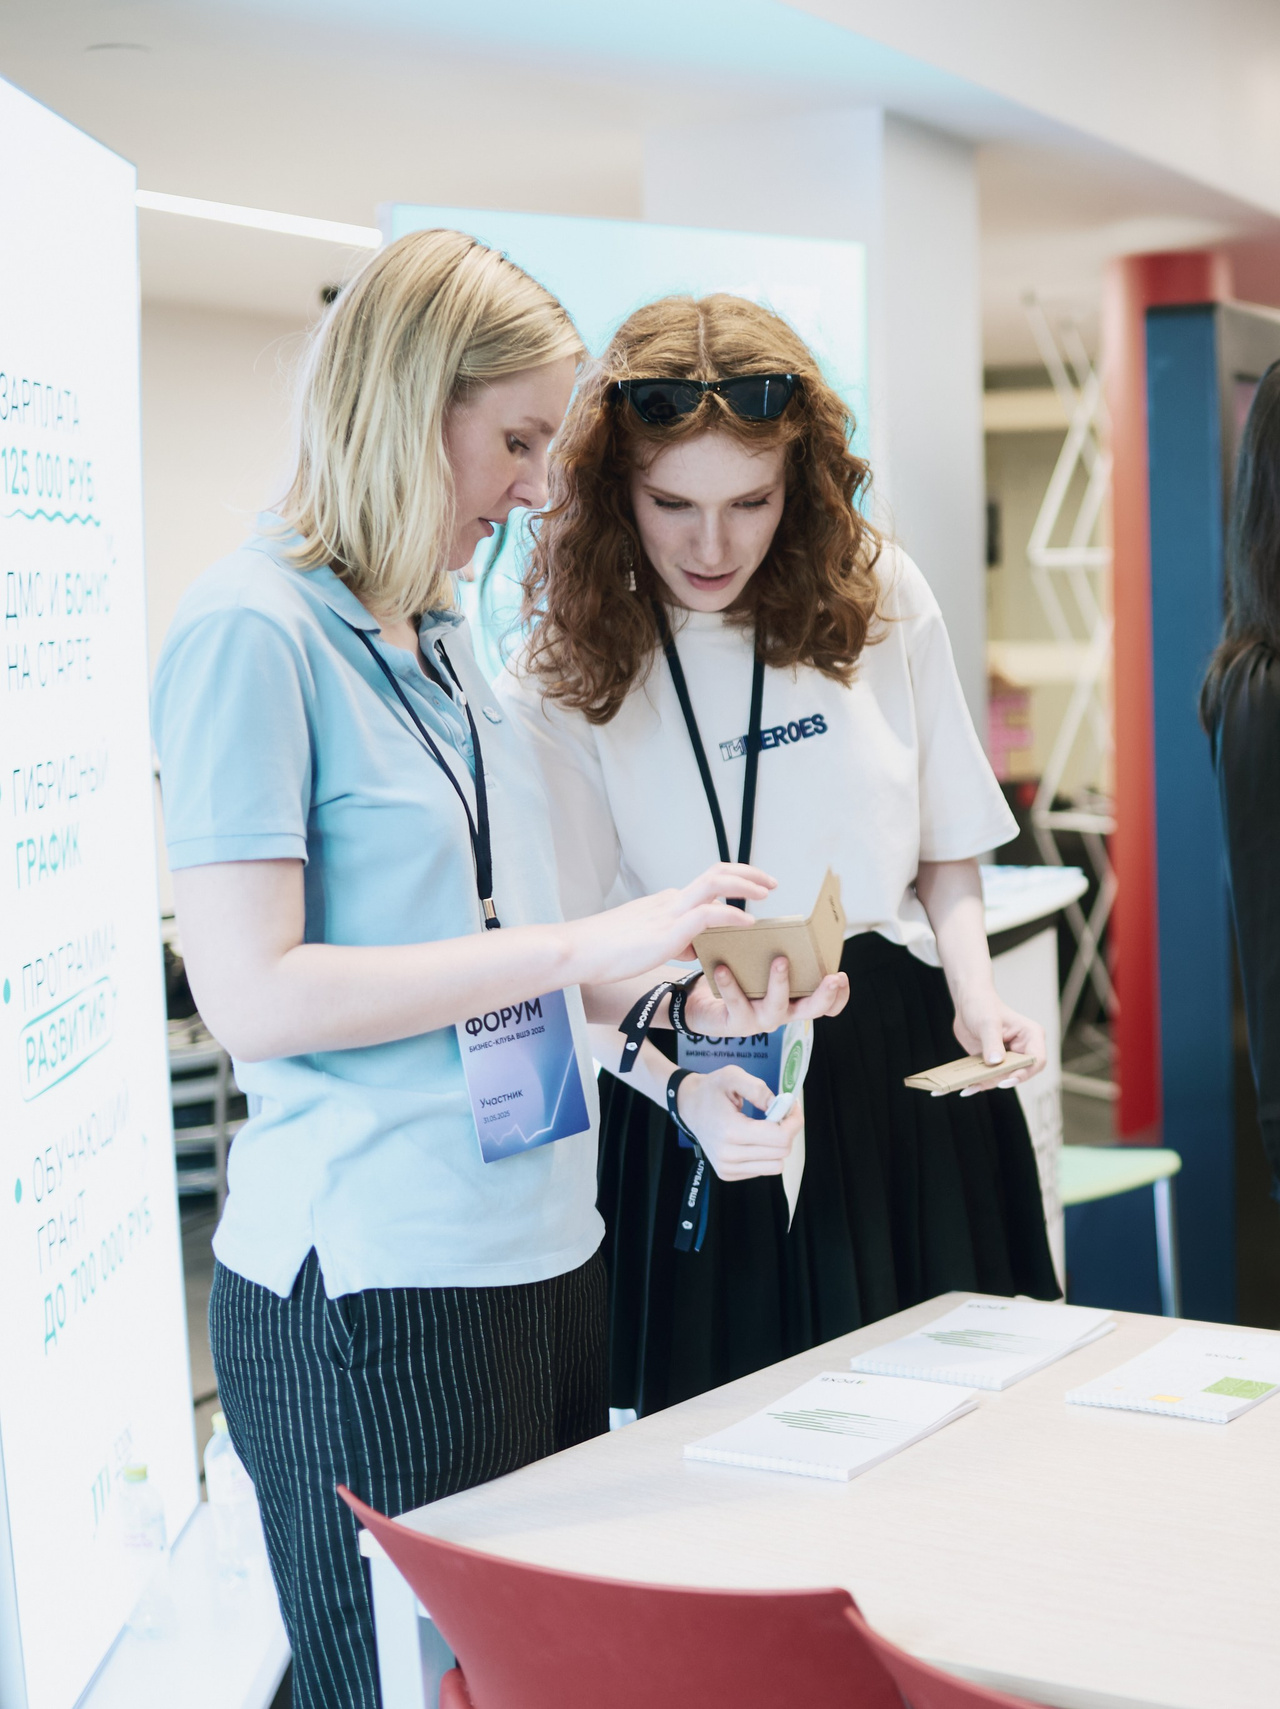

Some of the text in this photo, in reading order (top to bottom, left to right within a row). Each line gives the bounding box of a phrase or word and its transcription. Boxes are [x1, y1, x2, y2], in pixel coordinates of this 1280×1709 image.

[0, 371, 80, 434] ЗАРПЛАТА
[1, 446, 96, 503] 125 000 РУБ
[5, 571, 44, 631] ДМС
[6, 636, 92, 692] НА СТАРТЕ
[15, 820, 83, 891] ГРАФИК
[25, 987, 108, 1085] РАЗВИТИЯ
[465, 998, 544, 1037] ФОРУМ
[469, 1025, 546, 1053] БИЗНЕС-КЛУБА ВШЭ 2025
[685, 1049, 769, 1060] БИЗНЕС-КЛУБА ВШЭ 2025
[480, 1089, 524, 1108] Участник
[37, 1188, 87, 1276] ГРАНТ
[44, 1281, 68, 1357] ДО
[70, 1250, 97, 1315] 700
[100, 1222, 125, 1283] 000
